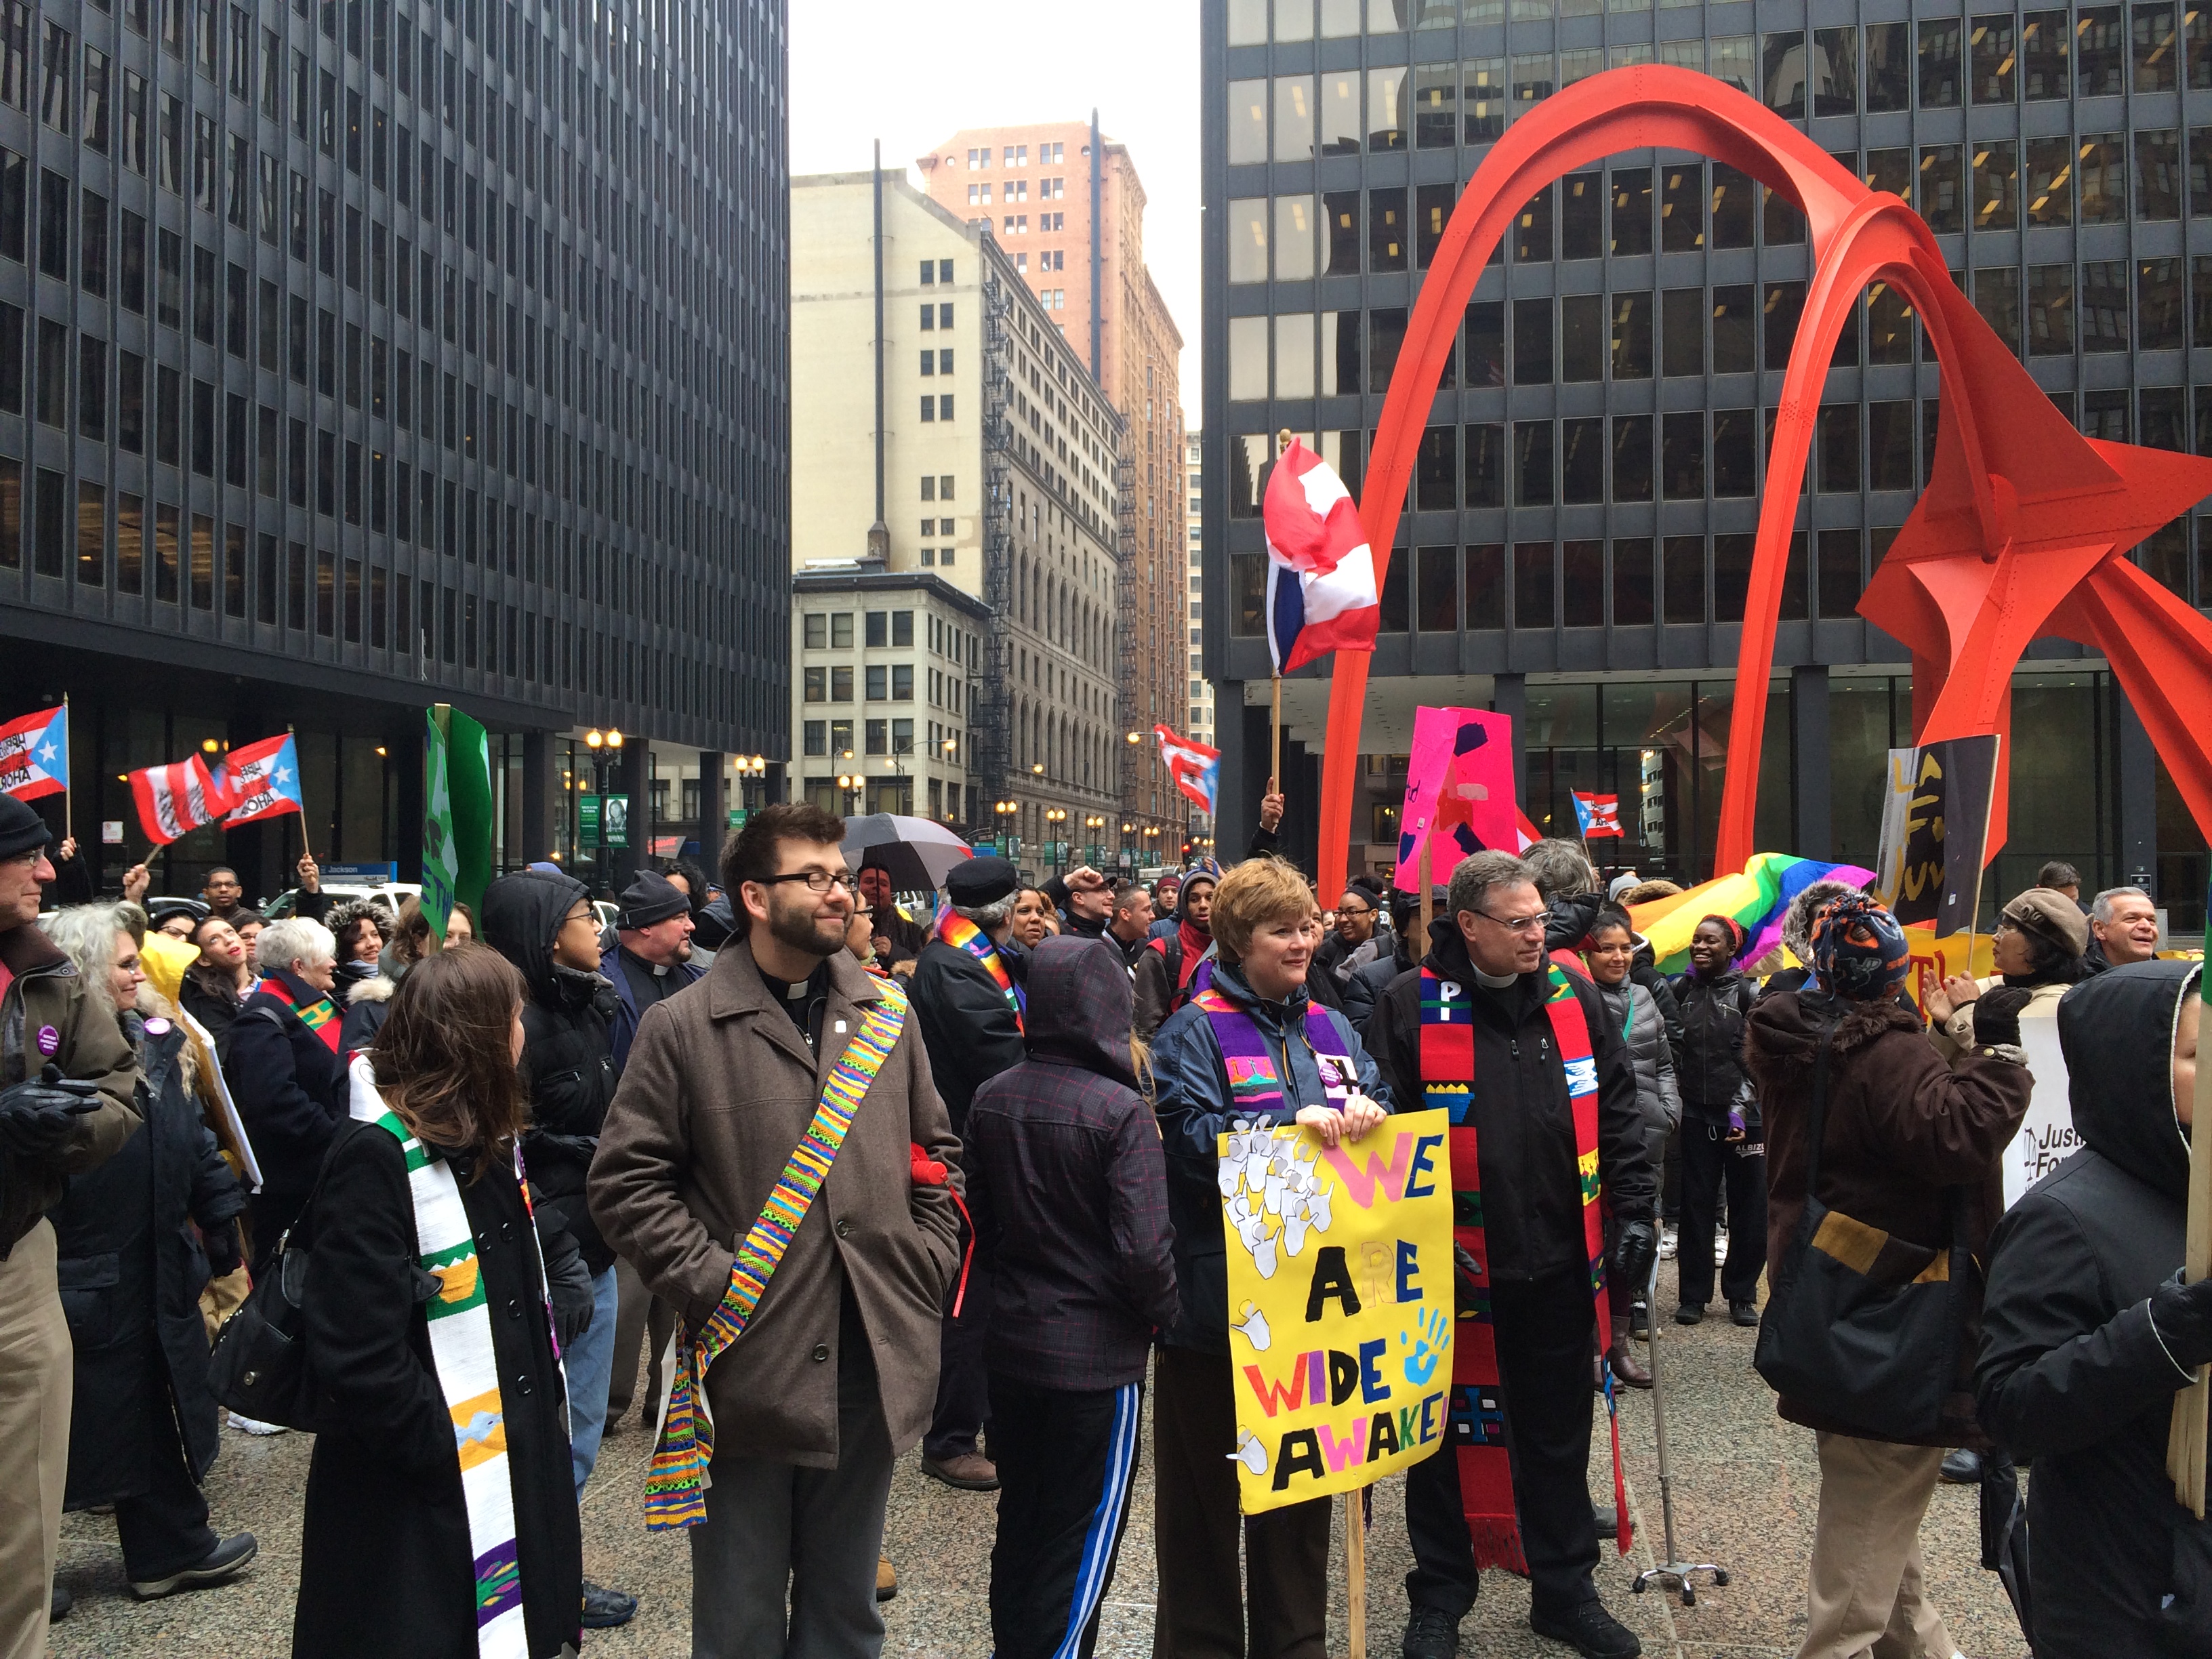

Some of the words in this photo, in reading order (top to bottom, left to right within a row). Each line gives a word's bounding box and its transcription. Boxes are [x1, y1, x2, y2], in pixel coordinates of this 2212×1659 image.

[1894, 752, 1942, 794] LA
[1873, 846, 1945, 908] JUV
[1322, 1132, 1445, 1210] WE
[1305, 1239, 1423, 1322] ARE
[1242, 1338, 1391, 1418] WIDE
[1271, 1391, 1449, 1493] AWAKE!
